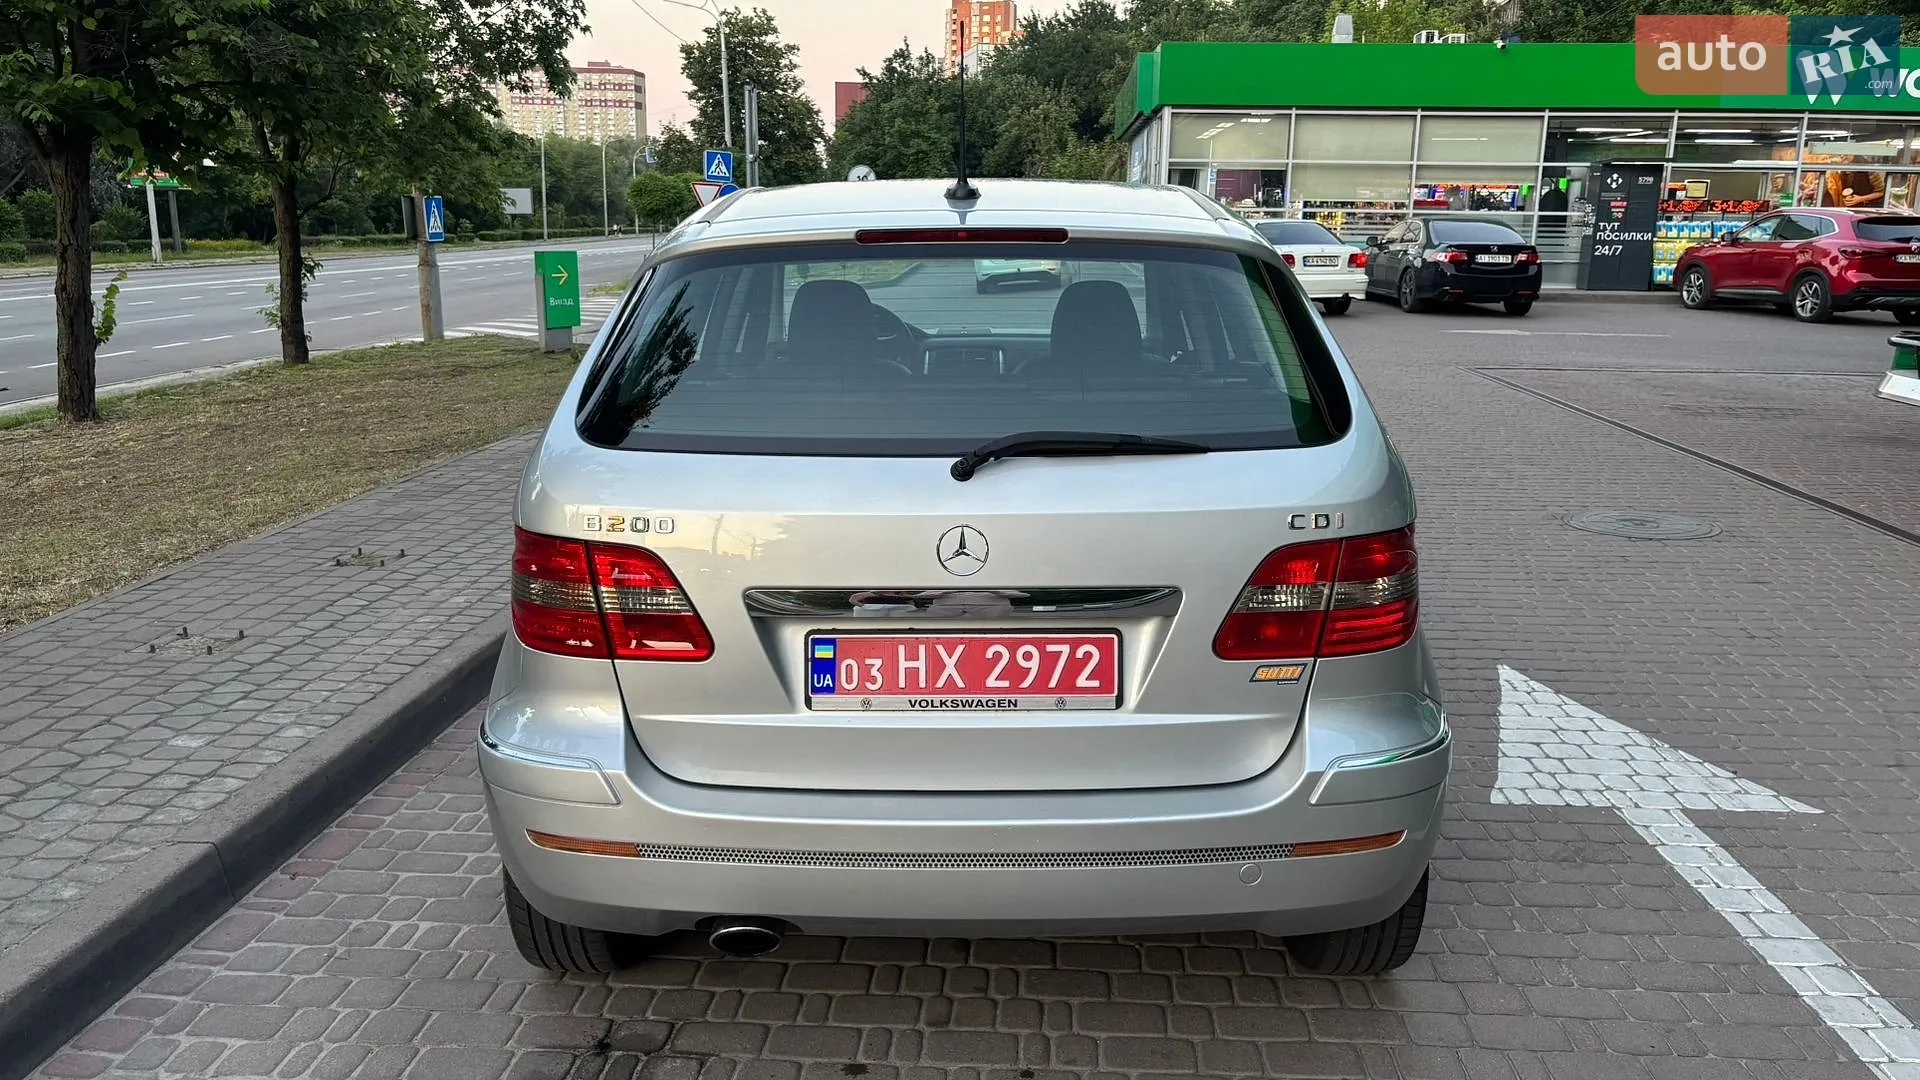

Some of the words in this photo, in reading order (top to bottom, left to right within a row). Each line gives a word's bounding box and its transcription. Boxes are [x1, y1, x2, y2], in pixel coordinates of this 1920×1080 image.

[1594, 245, 1623, 256] 24/7
[1287, 512, 1344, 530] CDI
[814, 673, 833, 688] UA
[840, 658, 883, 691] 03
[898, 643, 966, 689] HX
[985, 643, 1101, 689] 2972
[907, 698, 1018, 709] VOLKSWAGEN
